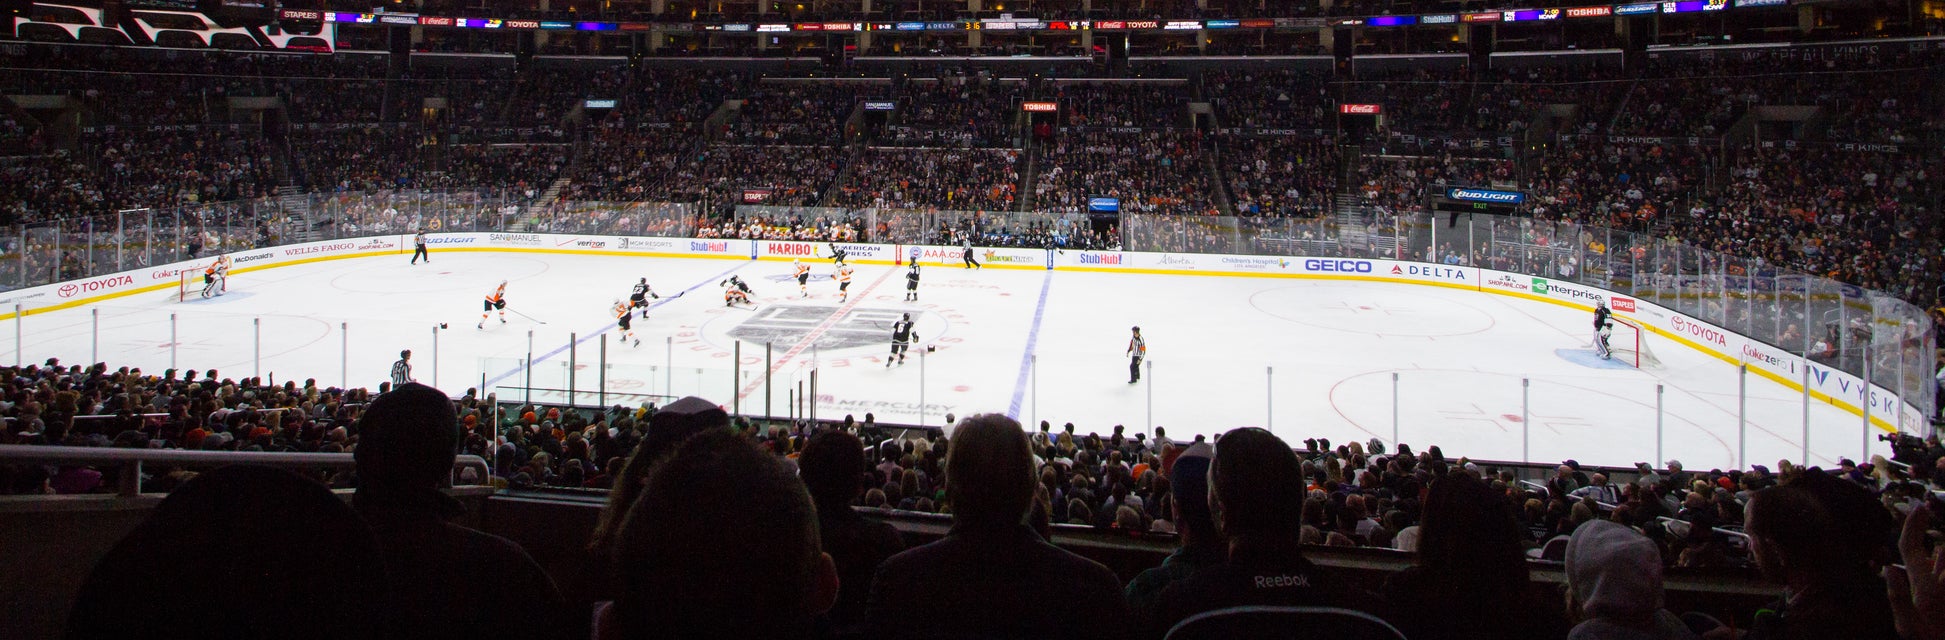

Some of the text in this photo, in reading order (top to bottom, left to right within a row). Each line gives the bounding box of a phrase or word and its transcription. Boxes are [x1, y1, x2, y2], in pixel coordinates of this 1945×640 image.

[284, 11, 317, 19] STAPLES
[1568, 6, 1611, 16] TOSHIBA
[1423, 14, 1455, 24] StubHub!
[1127, 21, 1157, 29] TOYOTA
[1457, 190, 1518, 201] BUD LIGHT
[511, 234, 542, 242] MANUEL
[285, 243, 355, 256] WELLS FARGO
[577, 240, 605, 248] verizon
[691, 242, 727, 252] StubHub!
[768, 243, 811, 255] HARIBO
[234, 253, 274, 263] McDonald's
[1080, 253, 1122, 265] StubHub!
[1252, 259, 1279, 267] Hospital
[1305, 258, 1372, 274] GEICO
[152, 269, 175, 280] Coke
[1409, 265, 1465, 281] DELTA
[82, 275, 133, 293] TOYOTA
[1536, 281, 1602, 301] enterprise
[1612, 299, 1634, 309] STAPLES
[1686, 321, 1727, 347] TOYOTA
[1743, 344, 1766, 361] Coke
[839, 399, 956, 411] MERCURY
[1254, 574, 1310, 588] Reebok
